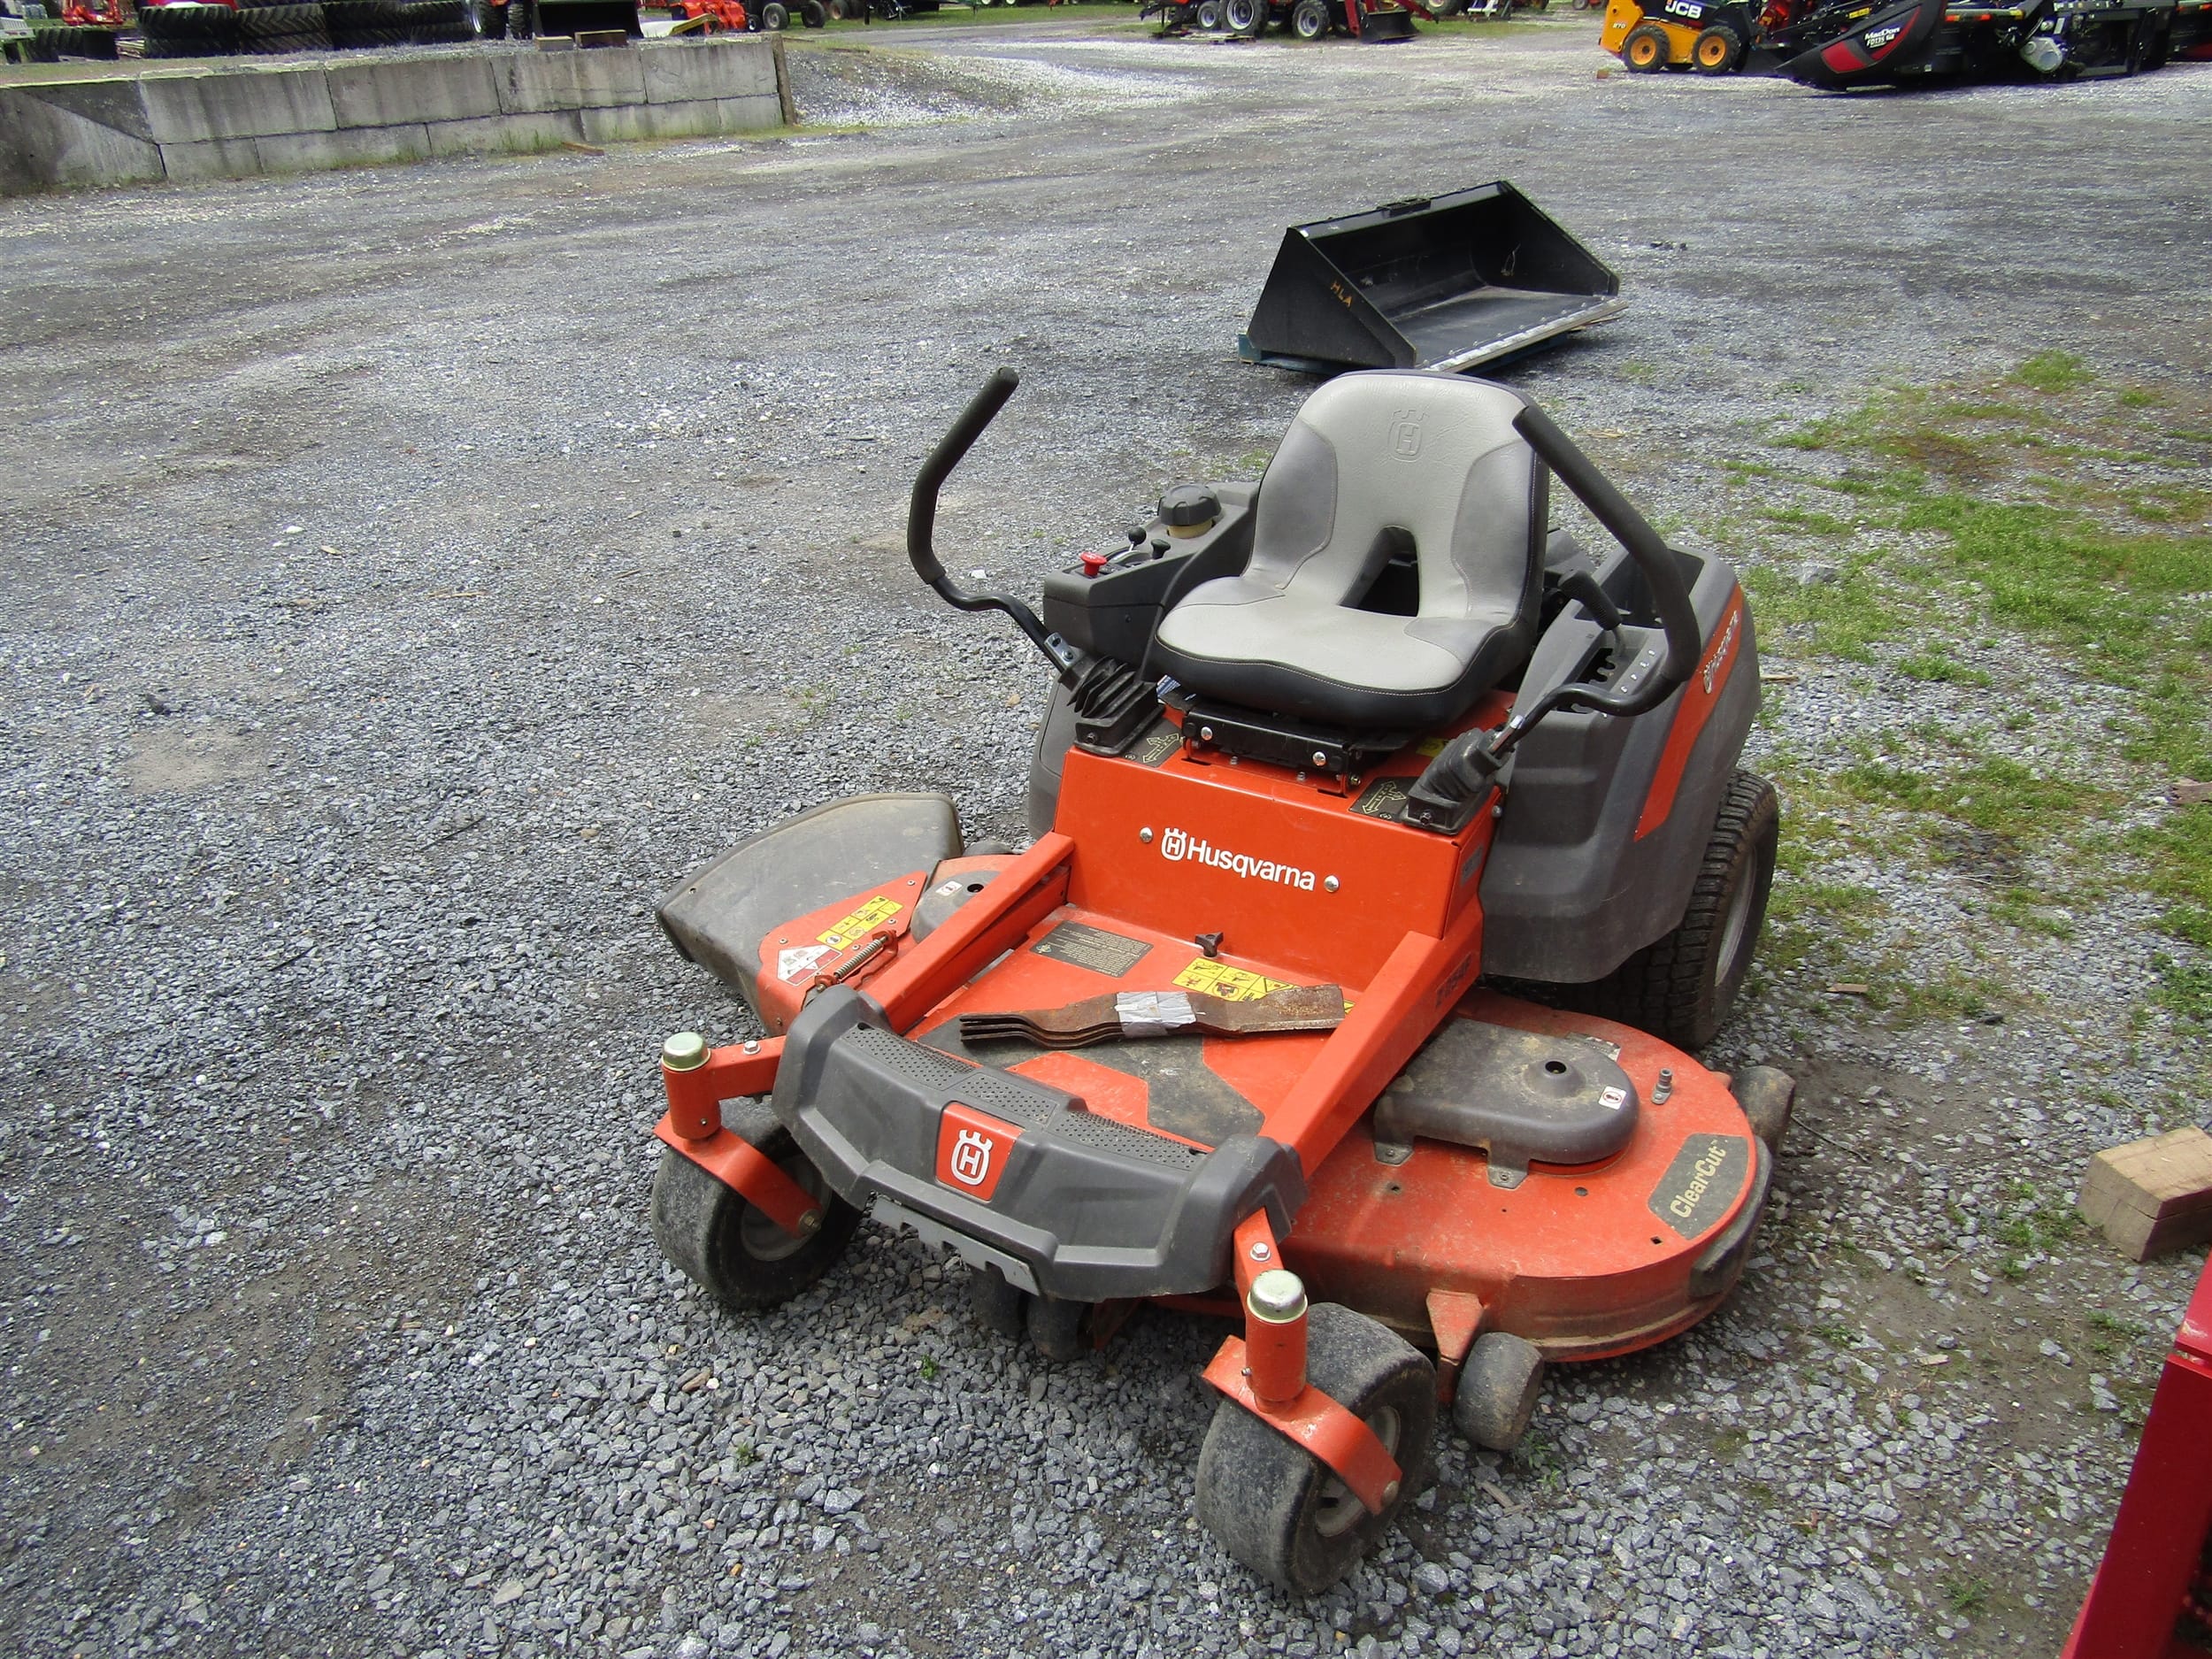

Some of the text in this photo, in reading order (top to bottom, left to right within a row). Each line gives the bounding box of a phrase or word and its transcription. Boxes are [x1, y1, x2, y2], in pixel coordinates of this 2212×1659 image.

[1664, 1, 1702, 19] JCB
[1864, 27, 1901, 40] MacDon
[1187, 837, 1316, 891] Husqvarna
